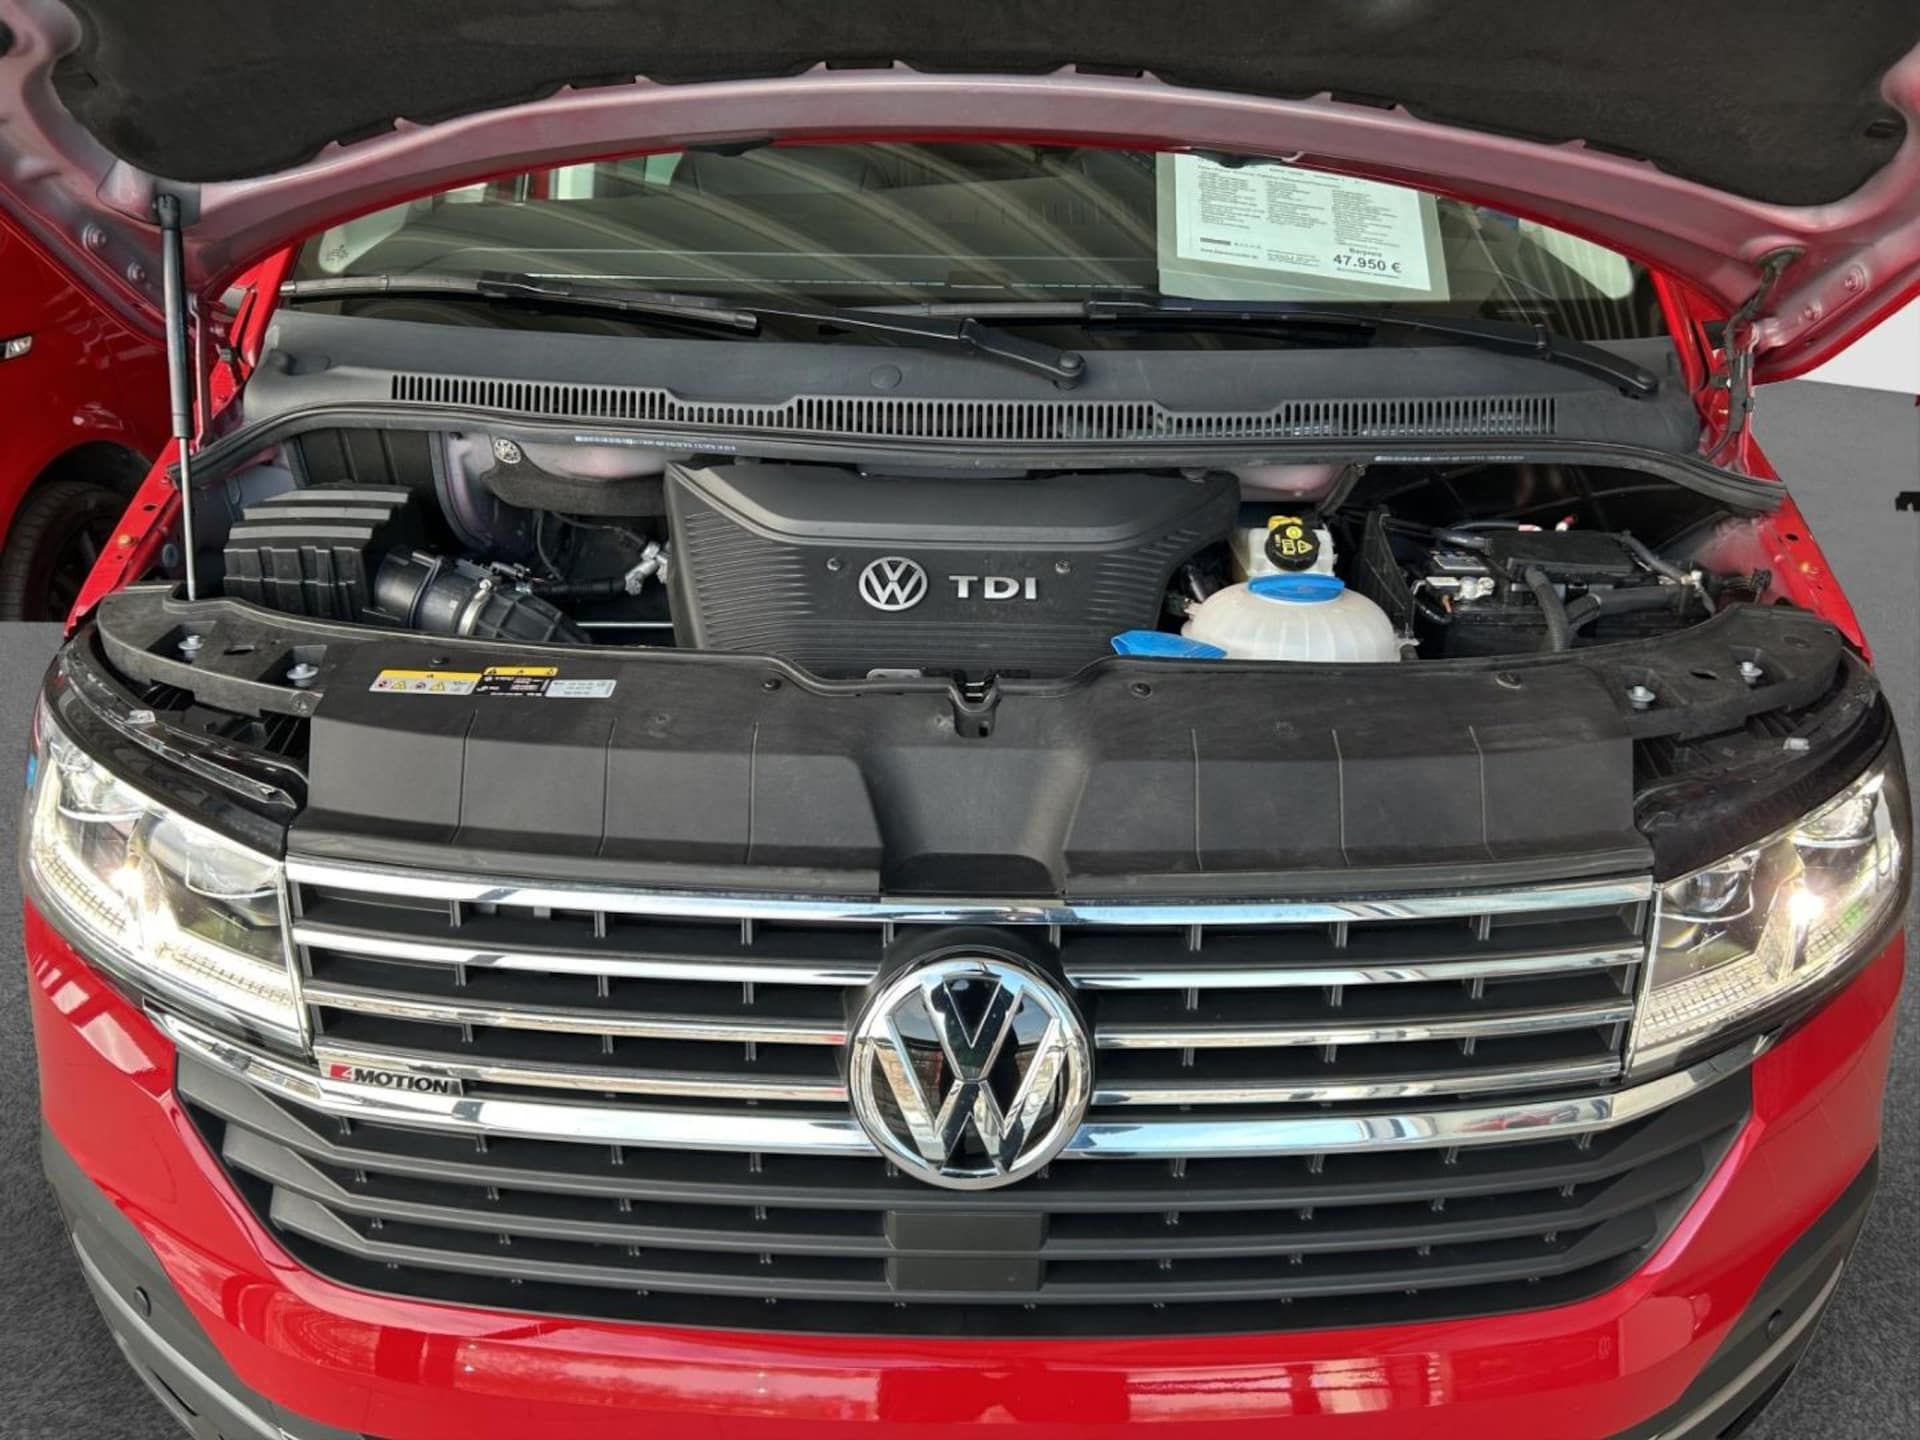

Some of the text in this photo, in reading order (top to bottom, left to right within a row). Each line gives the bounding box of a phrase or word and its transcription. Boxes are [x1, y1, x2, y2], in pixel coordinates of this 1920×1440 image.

[1333, 254, 1387, 272] 47.950
[1391, 262, 1402, 274] €
[859, 556, 928, 611] VW
[949, 575, 1037, 600] TDI
[851, 956, 1092, 1190] VW
